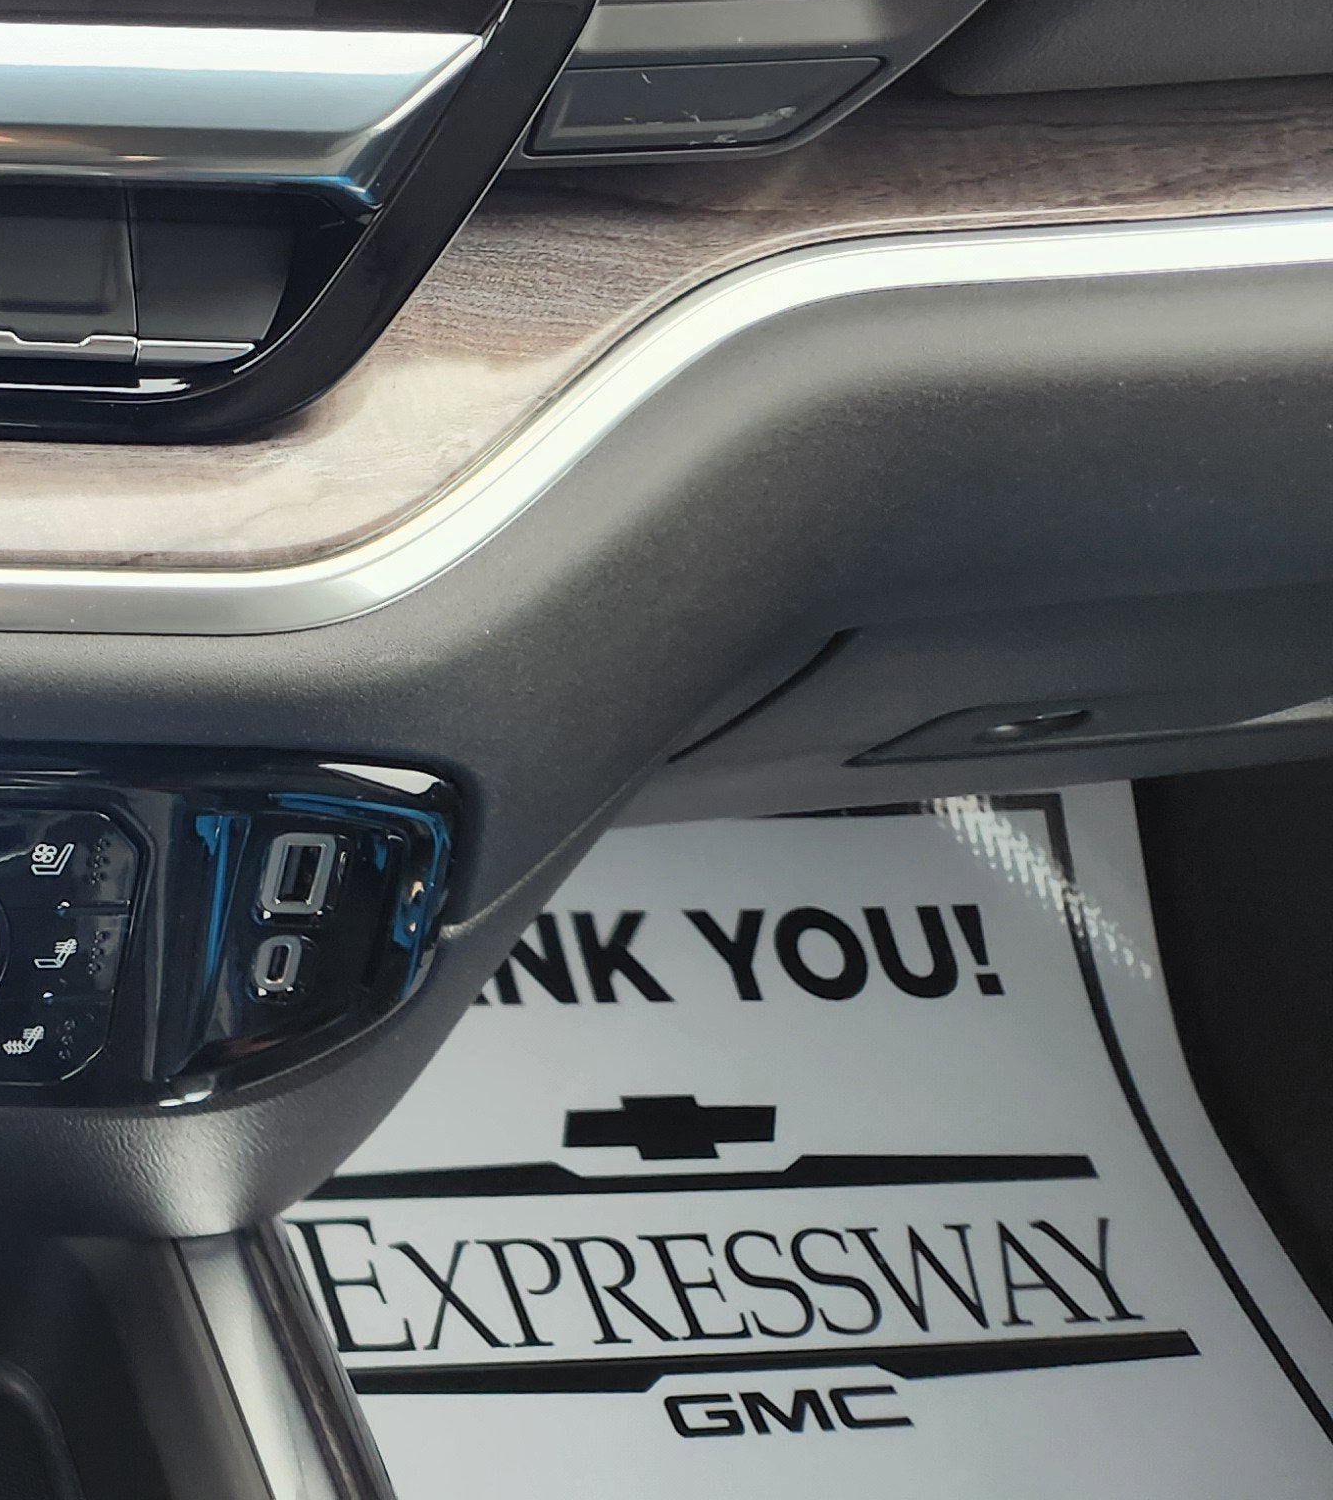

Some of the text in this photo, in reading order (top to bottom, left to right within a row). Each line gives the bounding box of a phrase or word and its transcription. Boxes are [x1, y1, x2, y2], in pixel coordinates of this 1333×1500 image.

[689, 905, 1007, 1003] YOU!
[291, 1215, 1145, 1353] EXPRESSWAY
[663, 1384, 913, 1439] GMC
